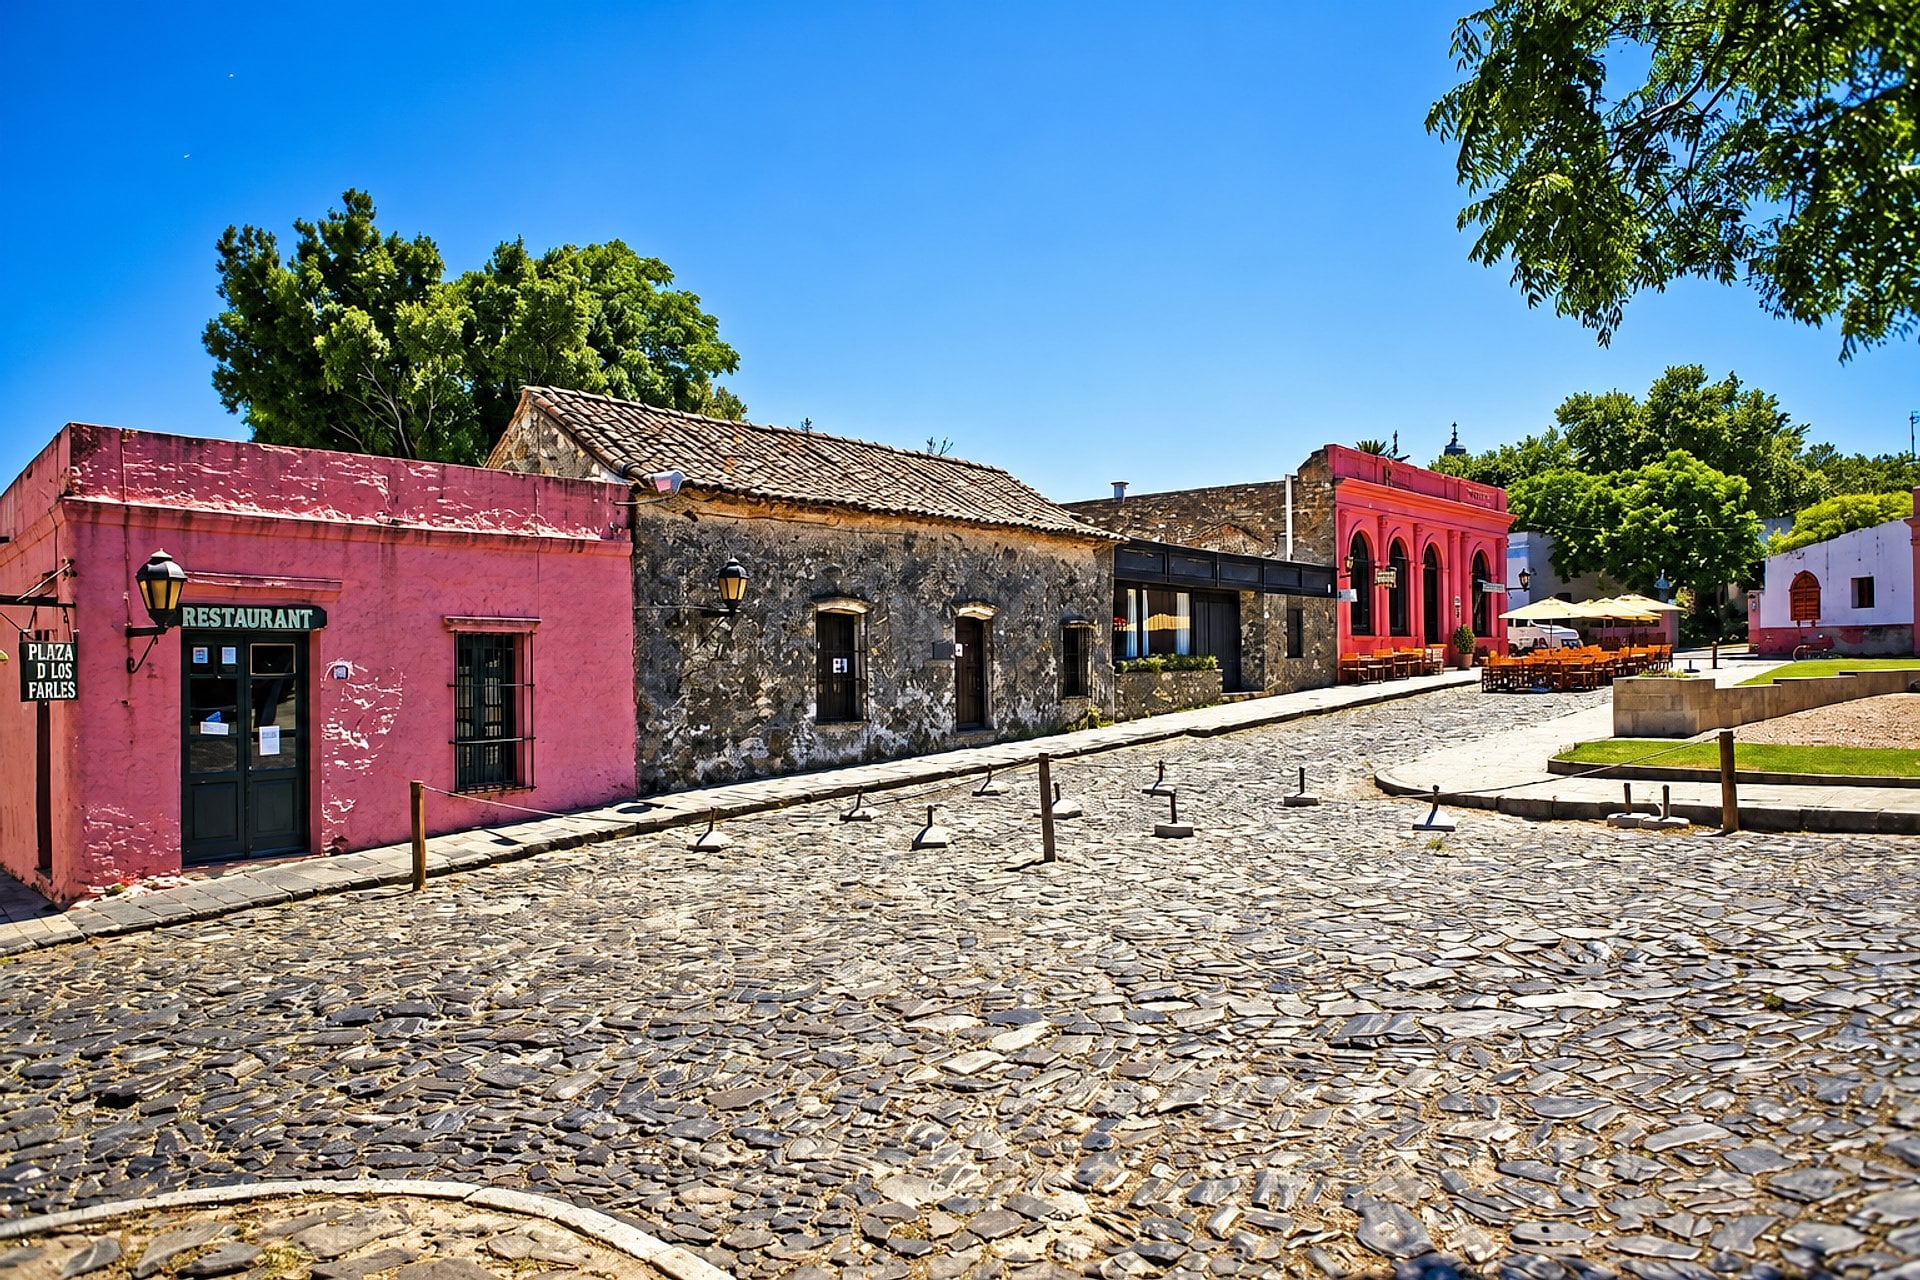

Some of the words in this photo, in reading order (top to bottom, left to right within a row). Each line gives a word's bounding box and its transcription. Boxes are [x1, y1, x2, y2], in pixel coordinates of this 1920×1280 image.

[182, 606, 313, 629] RESTAURANT
[28, 643, 73, 661] PLAZA
[37, 662, 46, 679] D
[51, 662, 73, 679] LOS
[28, 681, 76, 699] FARLES
